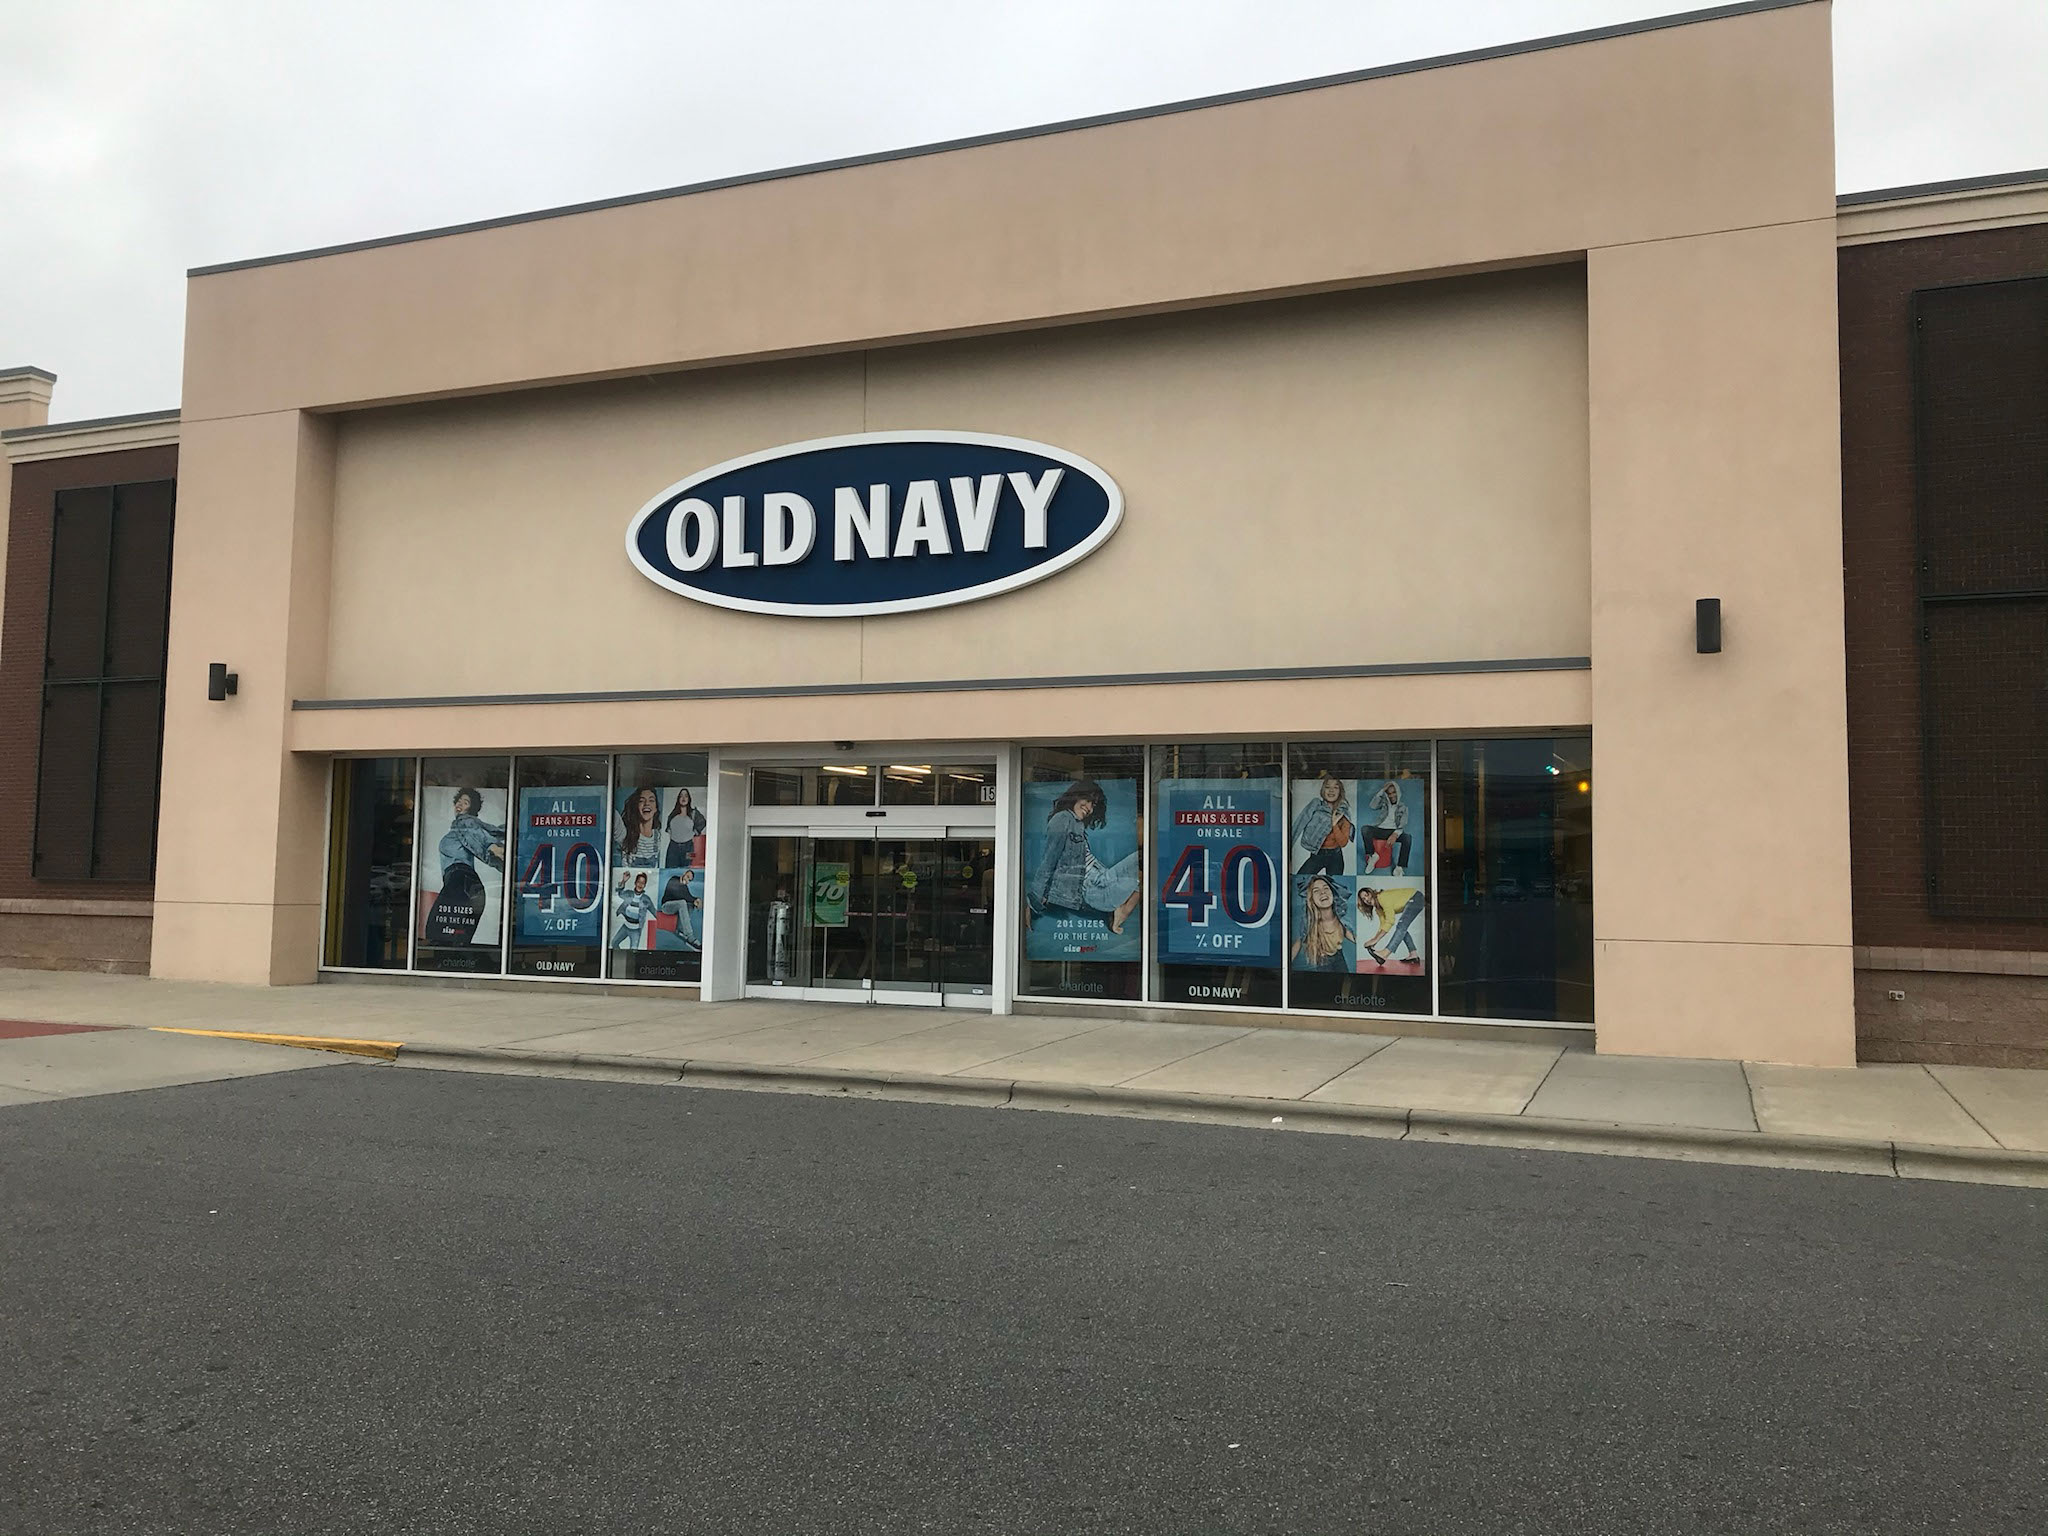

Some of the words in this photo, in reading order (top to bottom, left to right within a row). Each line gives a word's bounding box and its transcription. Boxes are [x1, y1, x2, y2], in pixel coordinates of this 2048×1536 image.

[665, 492, 816, 572] OLD
[834, 468, 1066, 562] NAVY
[552, 801, 576, 813] ALL
[1203, 795, 1235, 810] ALL
[535, 816, 562, 826] JEANS
[564, 817, 570, 825] &
[571, 816, 593, 825] TEES
[1180, 813, 1217, 824] JEANS
[1220, 813, 1227, 823] &
[1230, 813, 1259, 823] TEES
[547, 829, 558, 837] ON
[560, 829, 580, 837] SALE
[1197, 828, 1212, 838] ON
[1214, 828, 1242, 838] SALE
[520, 842, 604, 914] 40
[1162, 844, 1277, 928] 40
[438, 905, 451, 913] 201
[453, 905, 473, 915] SIZES
[435, 915, 448, 923] FOR
[449, 916, 461, 925] THE
[462, 918, 475, 926] FAM
[544, 919, 553, 931] %
[556, 919, 578, 931] OFF
[1056, 920, 1074, 928] 201
[1077, 919, 1105, 928] SIZES
[1053, 932, 1070, 940] FOR
[1072, 932, 1087, 940] THE
[1090, 932, 1109, 940] FAM
[1195, 934, 1207, 948] %
[1212, 934, 1243, 948] OFF
[536, 961, 552, 971] OLD
[553, 961, 575, 972] NAVY
[639, 965, 677, 976] charlotte
[1058, 981, 1104, 993] charlotte
[1188, 985, 1210, 997] OLD
[1212, 986, 1242, 999] NAVY
[1334, 993, 1386, 1007] charlotte
